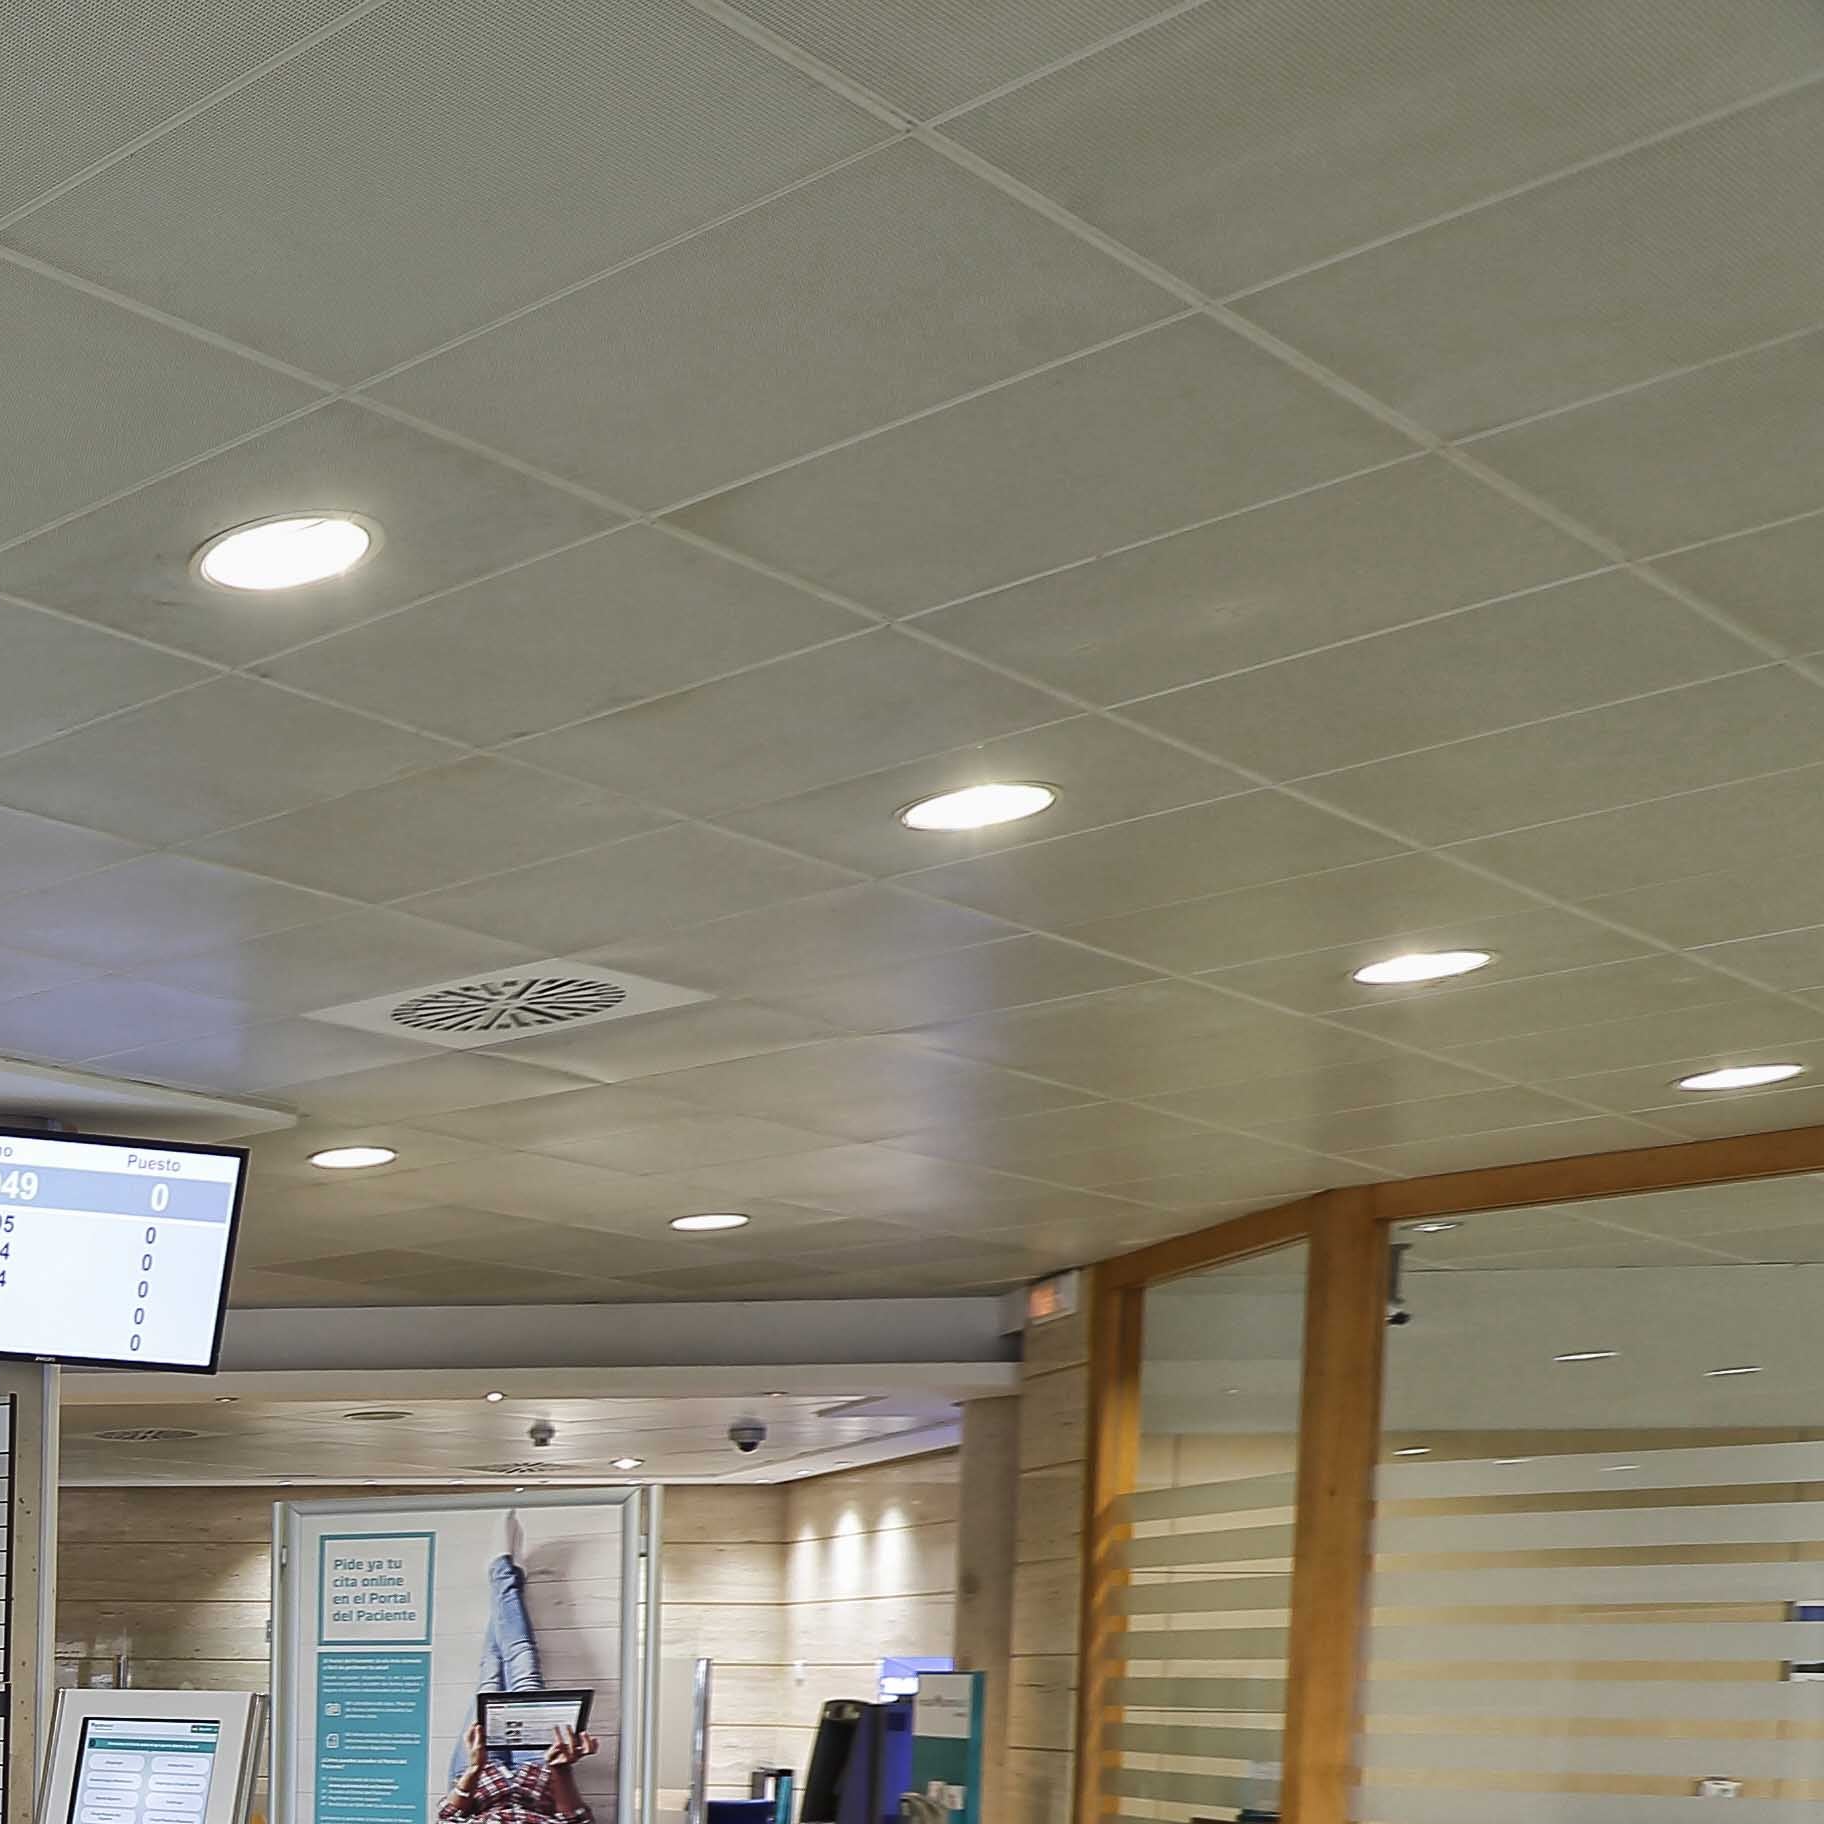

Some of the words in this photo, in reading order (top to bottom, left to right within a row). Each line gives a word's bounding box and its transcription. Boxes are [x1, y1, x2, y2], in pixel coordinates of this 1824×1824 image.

[128, 1155, 181, 1173] Puesto
[151, 1183, 170, 1212] 0
[145, 1227, 156, 1244] 0
[141, 1254, 152, 1271] 0
[137, 1281, 148, 1298] 0
[134, 1308, 144, 1325] 0
[130, 1334, 141, 1351] 0
[334, 1558, 364, 1570] Pide
[368, 1560, 383, 1572] ya
[388, 1559, 402, 1569] tu
[333, 1576, 358, 1587] cita
[361, 1575, 404, 1587] online
[333, 1594, 349, 1604] en
[353, 1593, 366, 1604] el
[369, 1592, 411, 1604] Portal
[332, 1610, 352, 1621] del
[357, 1610, 416, 1621] Paciente
